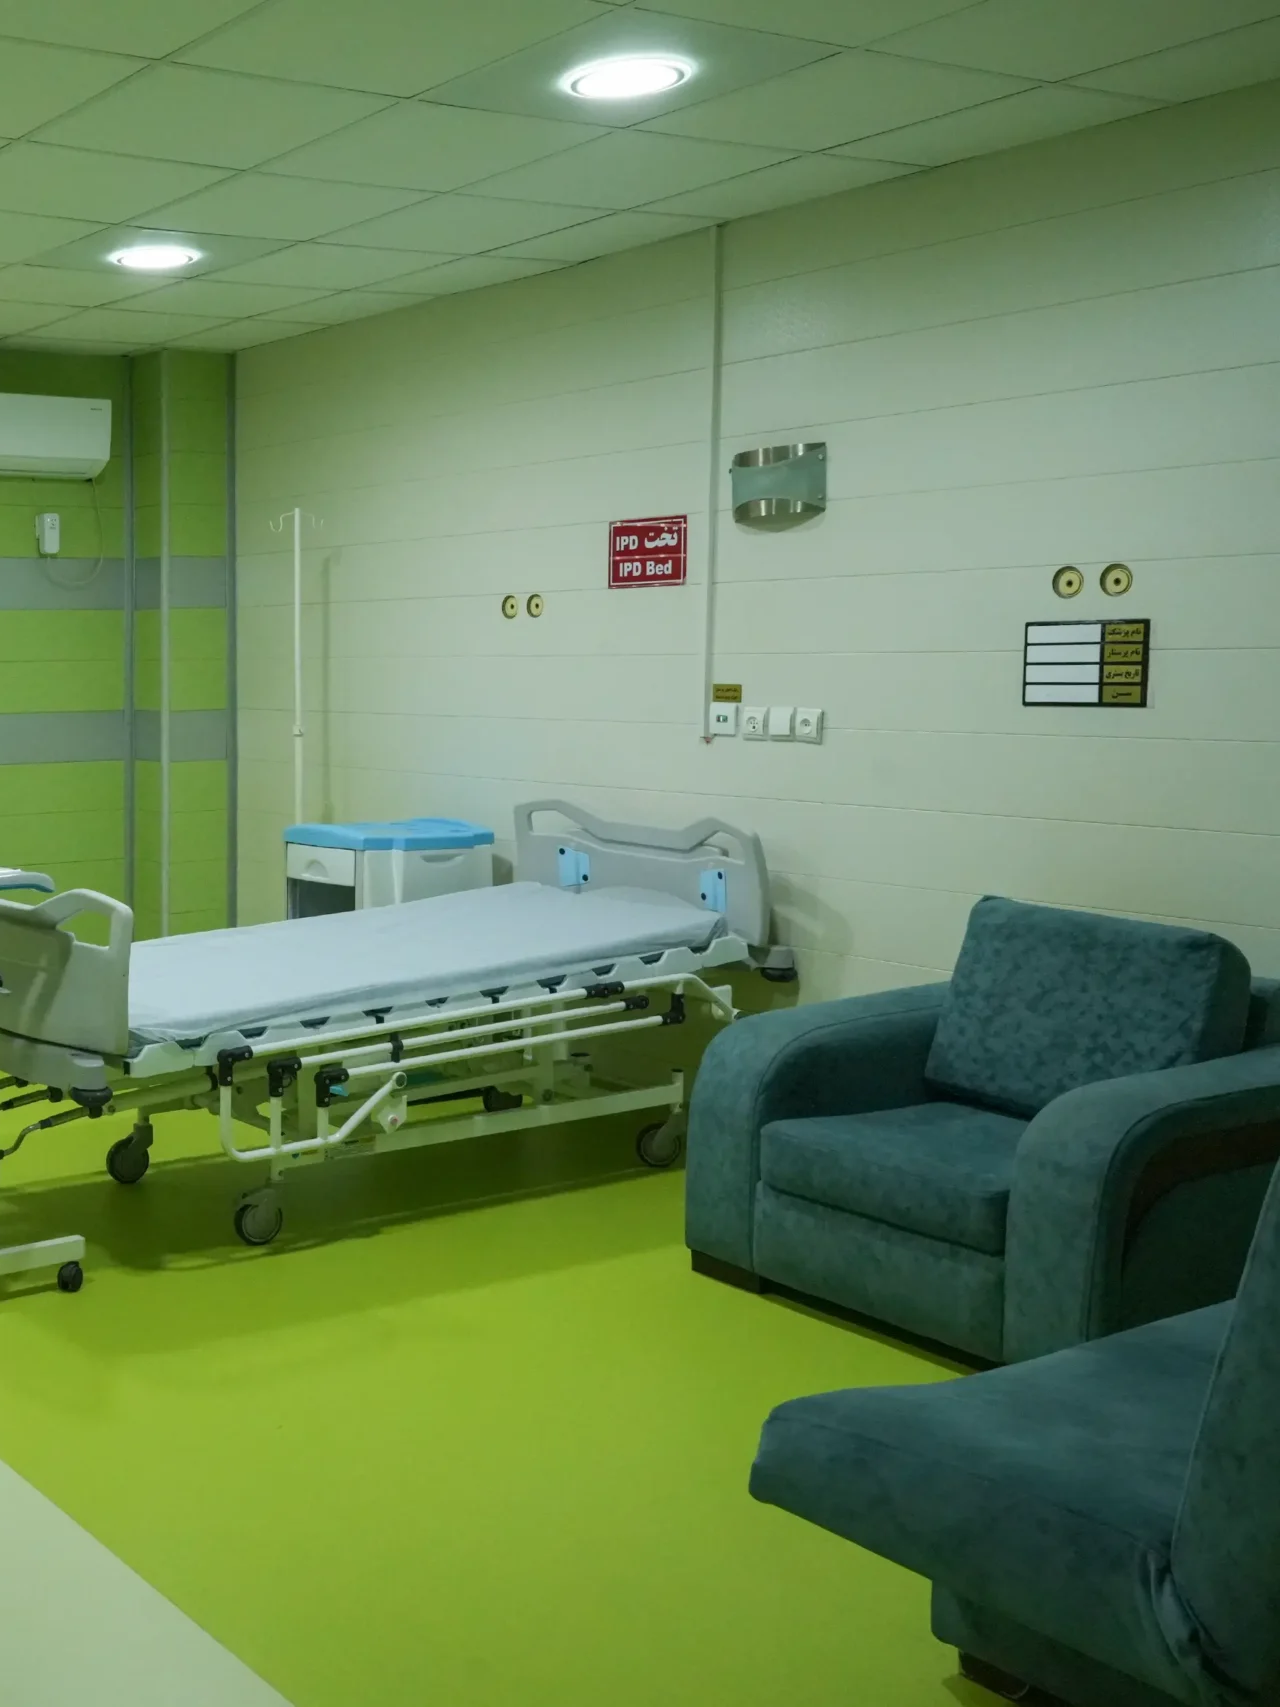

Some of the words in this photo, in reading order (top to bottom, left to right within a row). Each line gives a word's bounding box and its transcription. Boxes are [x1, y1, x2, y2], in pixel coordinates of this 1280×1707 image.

[644, 526, 678, 548] تخت
[616, 535, 638, 551] IPD
[619, 561, 642, 577] IPD
[646, 560, 672, 576] Bed
[1107, 627, 1130, 638] پزشک
[1107, 648, 1129, 658] پرستار
[1130, 648, 1141, 656] نام
[1105, 670, 1124, 680] بستری
[1124, 668, 1140, 679] تاریخ
